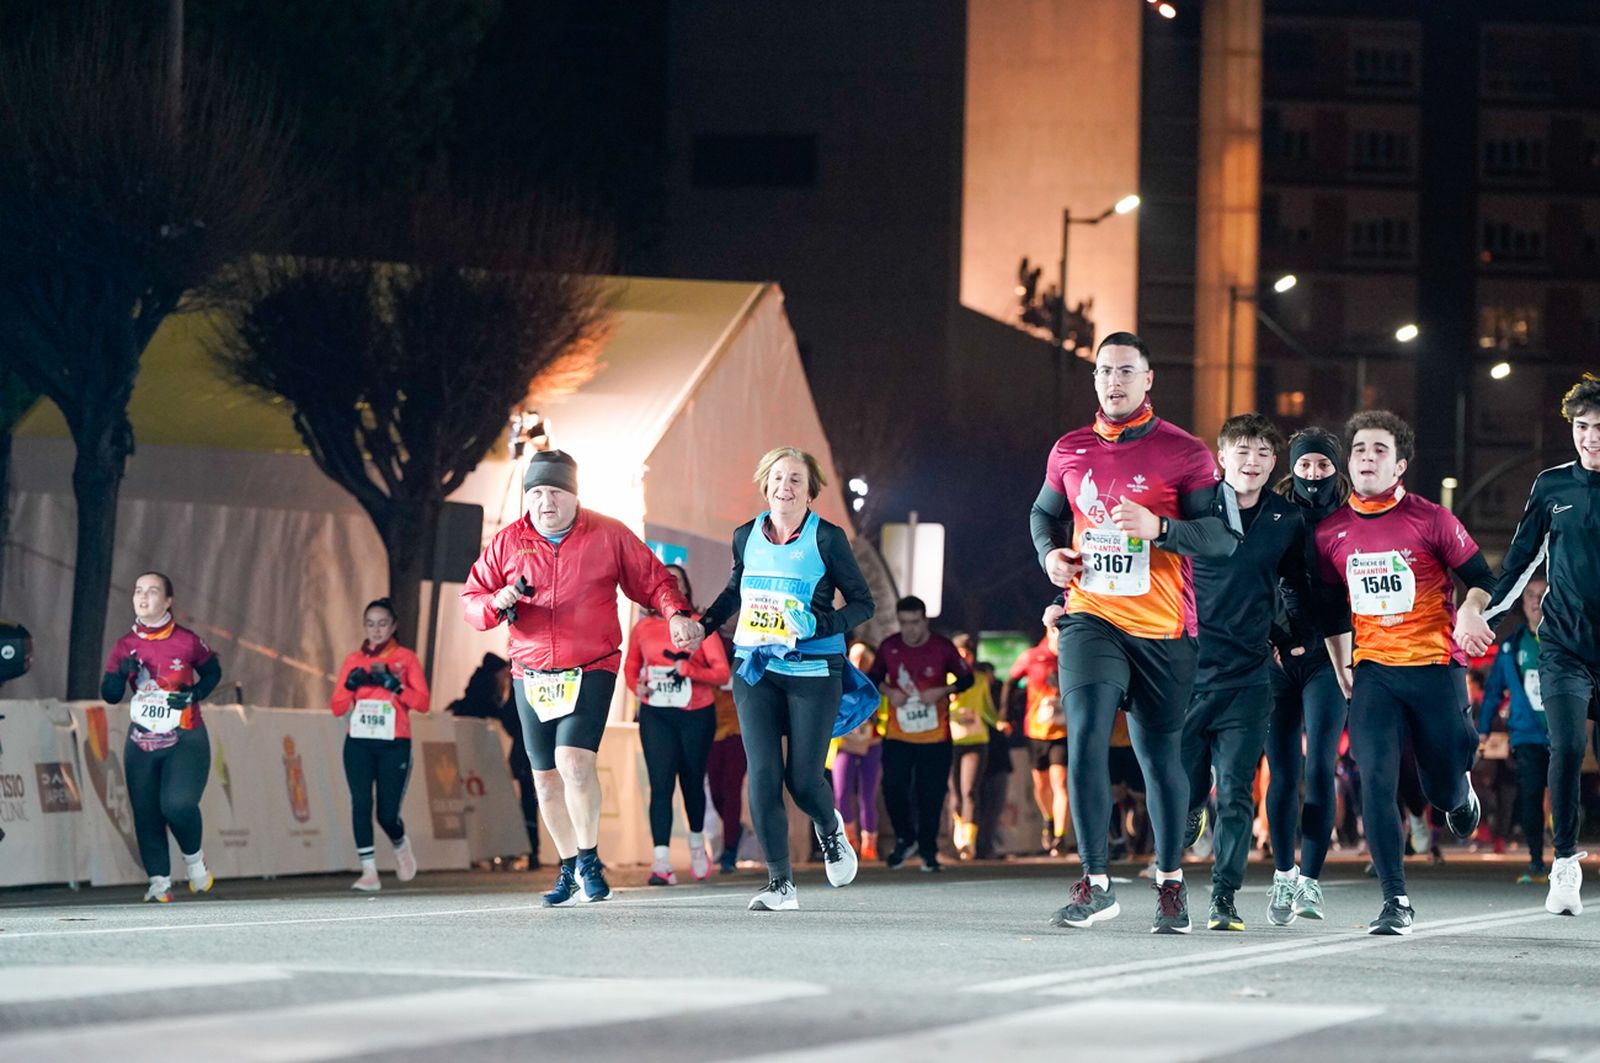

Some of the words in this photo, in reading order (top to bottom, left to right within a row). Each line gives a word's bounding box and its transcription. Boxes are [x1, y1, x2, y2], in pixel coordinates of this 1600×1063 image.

[1088, 505, 1105, 524] 43
[1093, 552, 1133, 574] 3167
[1360, 574, 1402, 594] 1546
[141, 703, 171, 720] 2801
[359, 713, 386, 726] 4198
